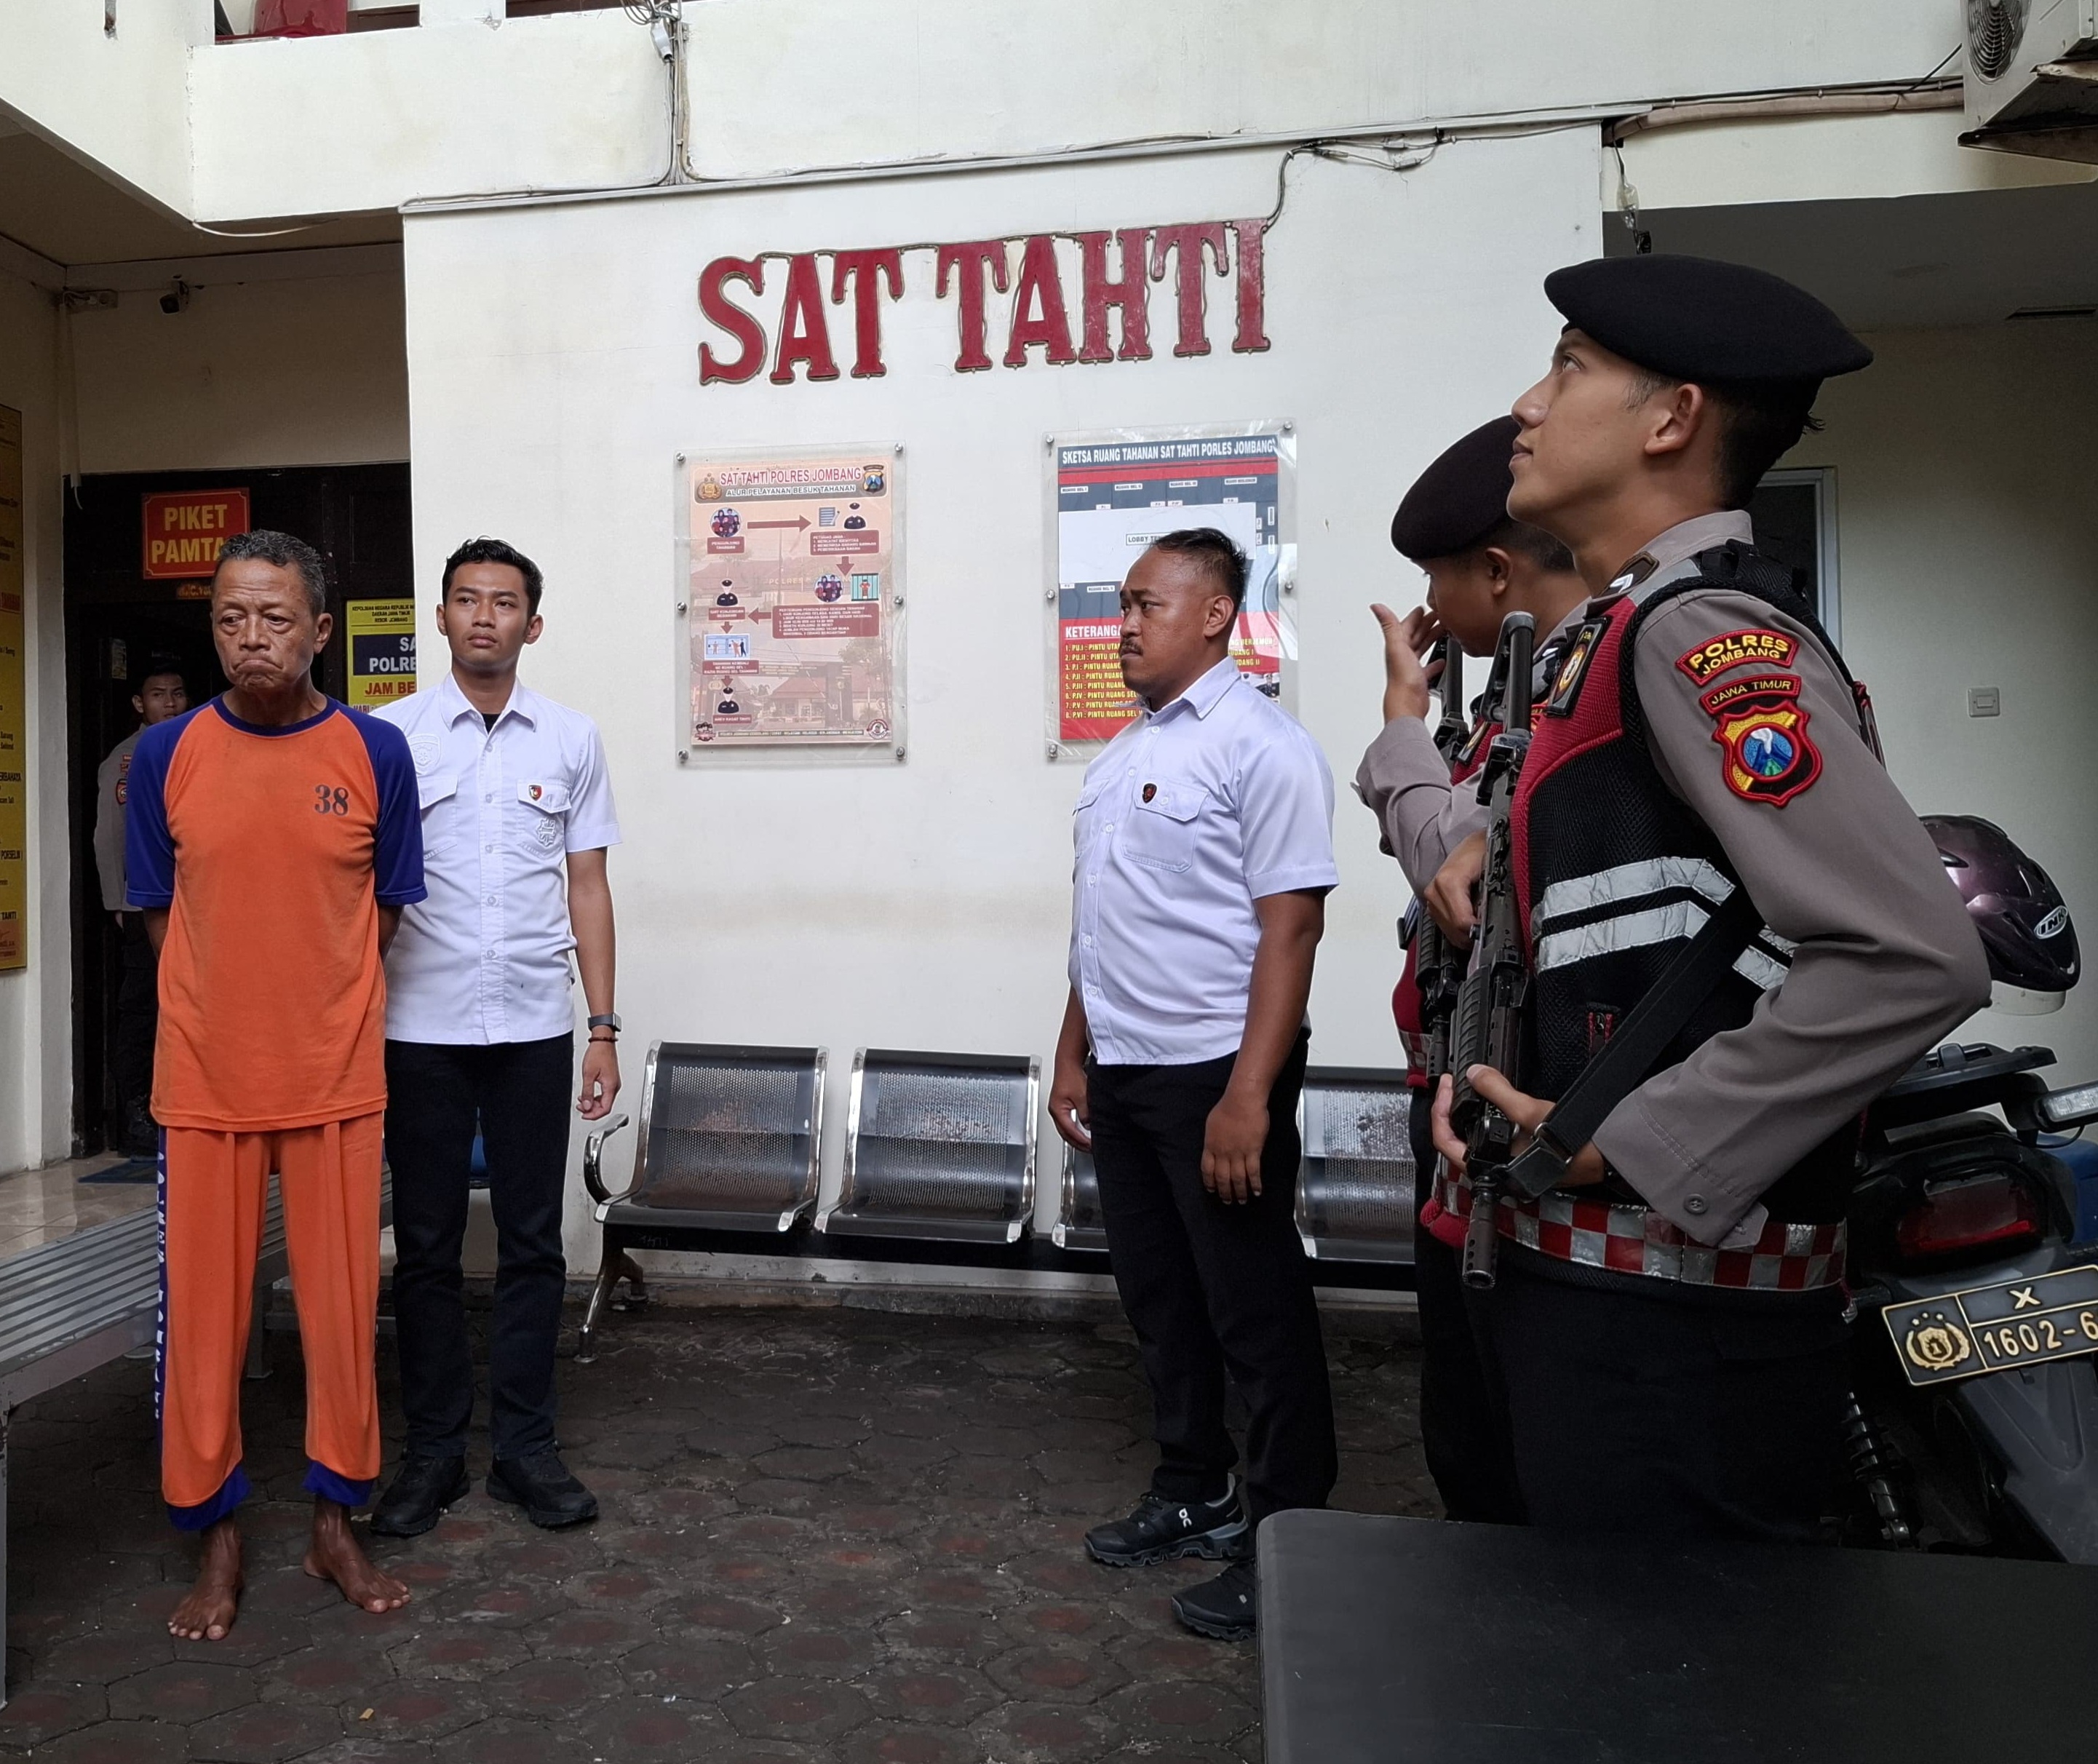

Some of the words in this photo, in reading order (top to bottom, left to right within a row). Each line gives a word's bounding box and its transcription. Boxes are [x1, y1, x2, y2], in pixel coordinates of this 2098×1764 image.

[698, 248, 904, 385] SAT
[936, 219, 1271, 373] TAHTI
[1062, 450, 1092, 464] SKETSA
[1094, 448, 1120, 462] RUANG
[1122, 446, 1159, 461] TAHANAN
[1161, 445, 1175, 458] SAT
[1177, 443, 1199, 457] TAHTI
[1201, 442, 1232, 456] PORLES
[1234, 440, 1273, 454] JOMBANG
[720, 472, 738, 485] SAT
[741, 470, 768, 484] TAHTI
[771, 469, 809, 482] POLRES
[811, 467, 862, 481] JOMBANG
[748, 487, 791, 495] PELAYANAN
[820, 485, 855, 493] TAHANAN
[164, 504, 228, 531] PIKET
[1089, 643, 1105, 651] PINTU
[1689, 635, 1789, 669] POLRES
[1703, 647, 1781, 675] JOMBANG
[365, 682, 393, 695] JAM
[1711, 684, 1748, 705] JAWA
[1752, 680, 1792, 690] TIMUR
[314, 784, 349, 816] 38
[2040, 908, 2066, 935] INK
[2009, 1286, 2041, 1310] X
